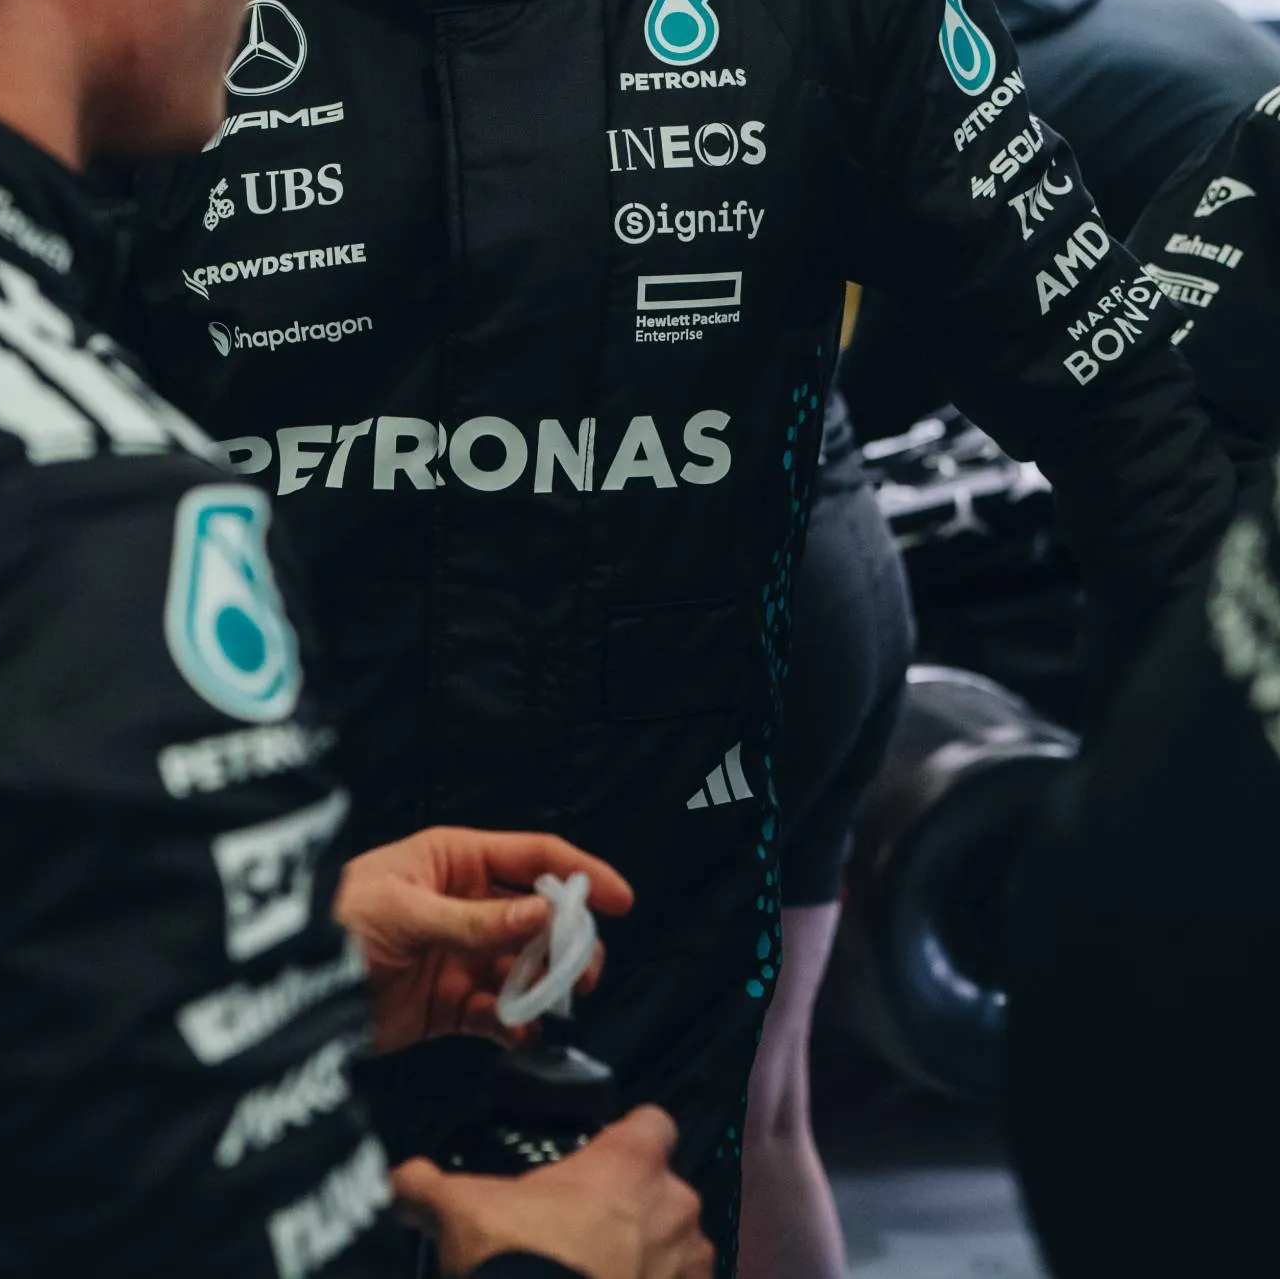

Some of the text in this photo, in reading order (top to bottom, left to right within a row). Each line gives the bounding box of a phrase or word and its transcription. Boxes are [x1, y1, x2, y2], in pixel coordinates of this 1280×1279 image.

[619, 68, 747, 91] PETRONAS
[606, 120, 767, 172] INEOS
[241, 163, 344, 215] UBS
[193, 242, 367, 286] CROWDSTRIKE
[1035, 221, 1110, 316] AMD
[234, 316, 373, 351] Snapdragon
[635, 310, 741, 328] Hewlett Packard
[635, 328, 703, 344] Enterprise
